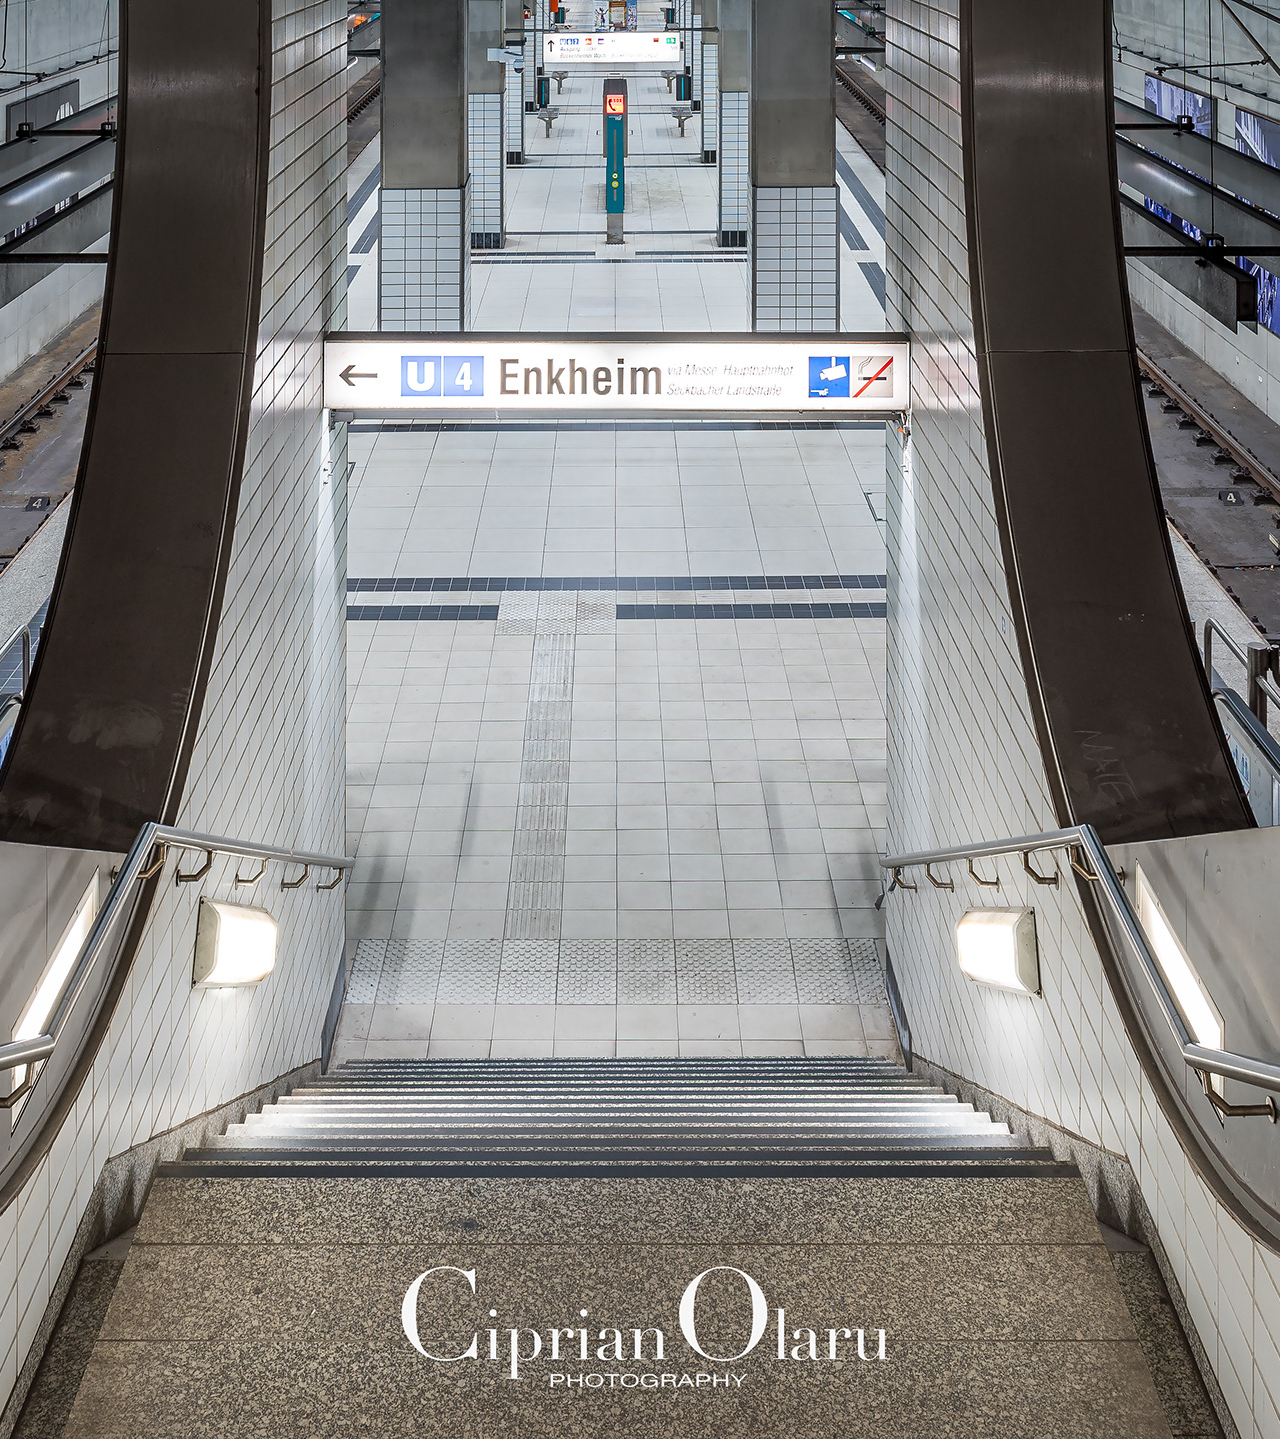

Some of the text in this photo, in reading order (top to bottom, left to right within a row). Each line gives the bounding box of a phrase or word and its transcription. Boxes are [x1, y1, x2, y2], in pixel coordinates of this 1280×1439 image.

[500, 358, 662, 396] Enkheim
[1226, 492, 1236, 503] 4
[32, 498, 43, 509] 4
